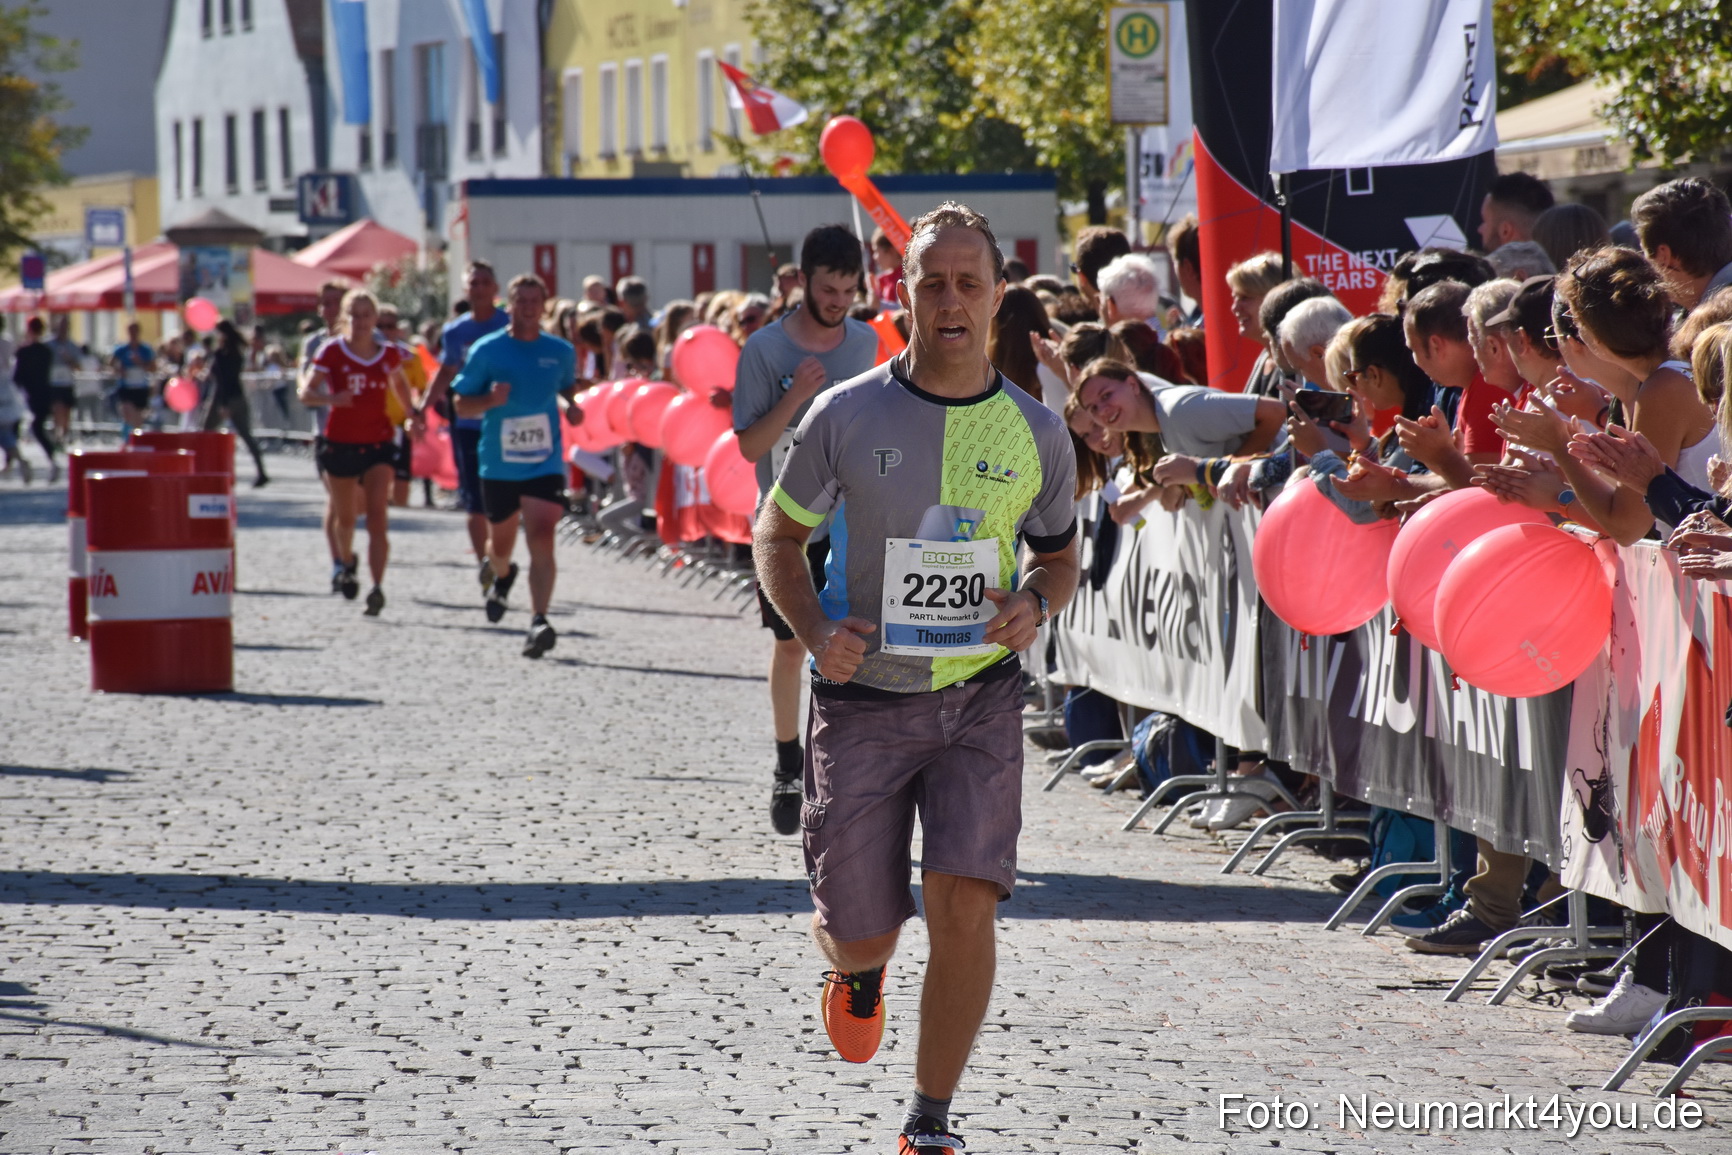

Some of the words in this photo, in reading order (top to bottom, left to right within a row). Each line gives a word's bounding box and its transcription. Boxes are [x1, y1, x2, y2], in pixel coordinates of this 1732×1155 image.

[1127, 23, 1149, 48] H
[1305, 253, 1344, 273] THE
[1347, 248, 1398, 270] NEXT
[1310, 270, 1377, 291] EARS
[508, 428, 545, 446] 2479
[922, 551, 975, 565] BOCK
[902, 572, 986, 609] 2230
[909, 613, 935, 621] PARTL
[937, 613, 971, 622] Neumarkt
[916, 629, 972, 644] Thomas
